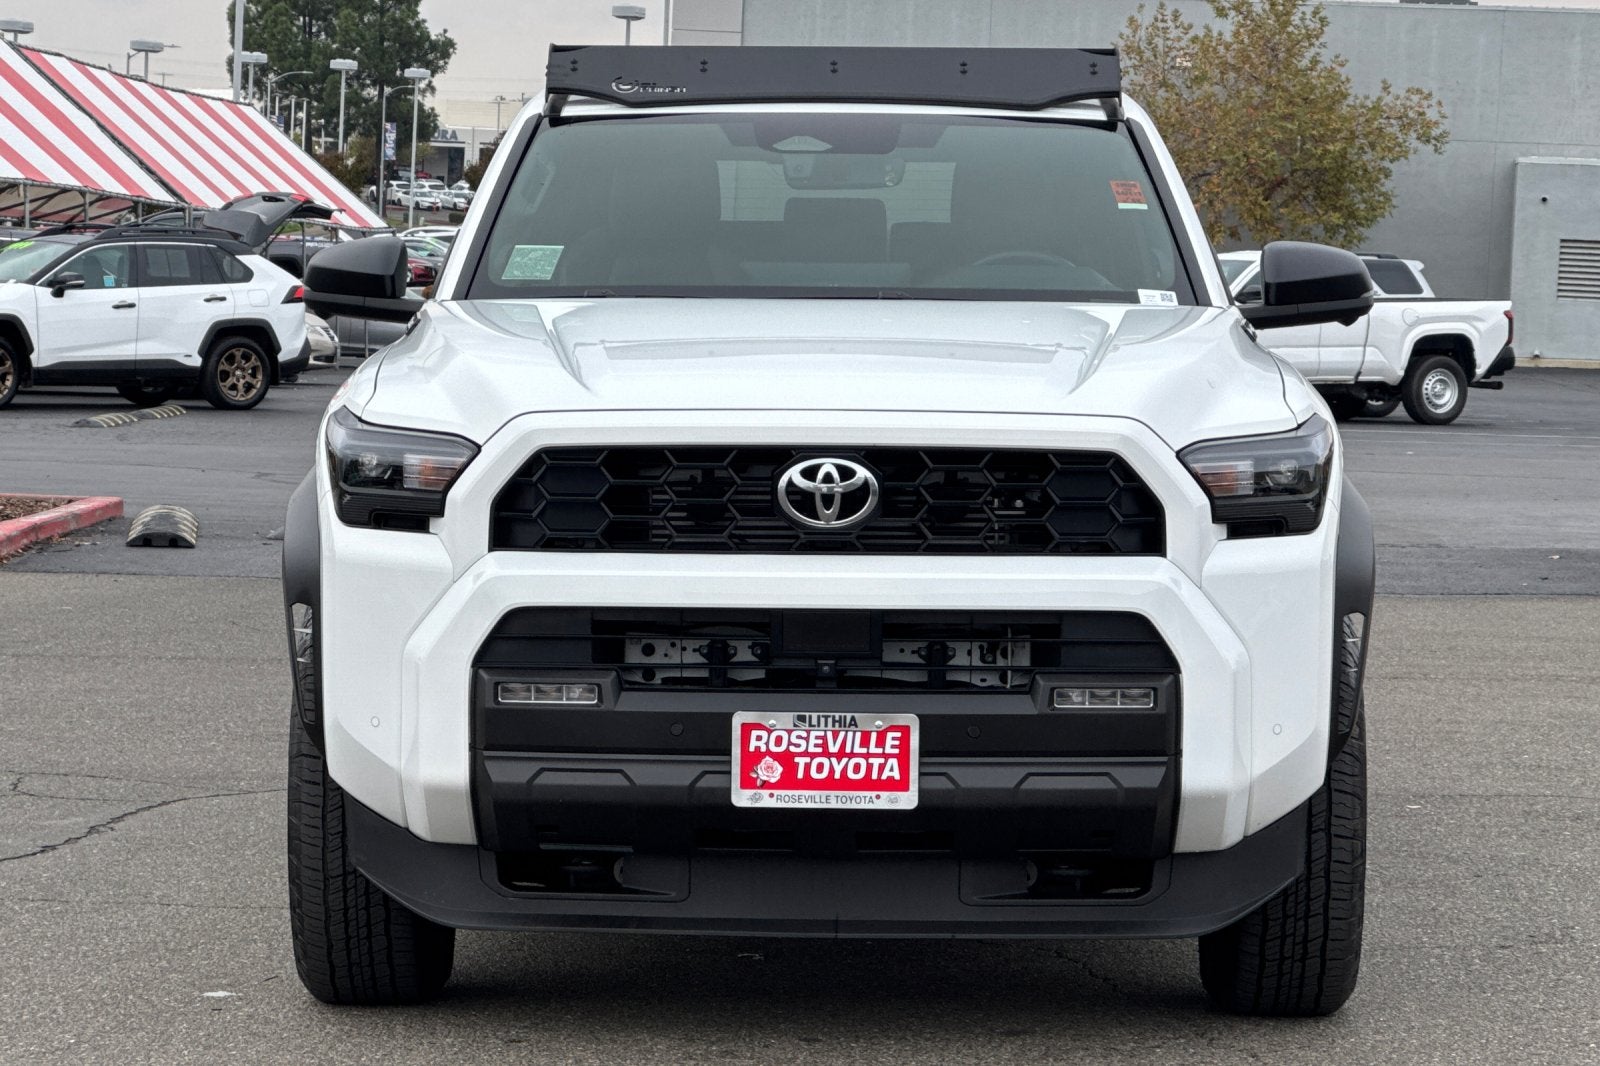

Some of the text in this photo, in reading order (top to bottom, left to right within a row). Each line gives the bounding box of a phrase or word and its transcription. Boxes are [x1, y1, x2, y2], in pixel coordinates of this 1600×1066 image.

[808, 714, 858, 728] LITHIA
[748, 730, 902, 754] ROSEVILLE
[793, 757, 901, 780] TOYOTA
[776, 793, 874, 805] ROSEVILLE TOYOTA
